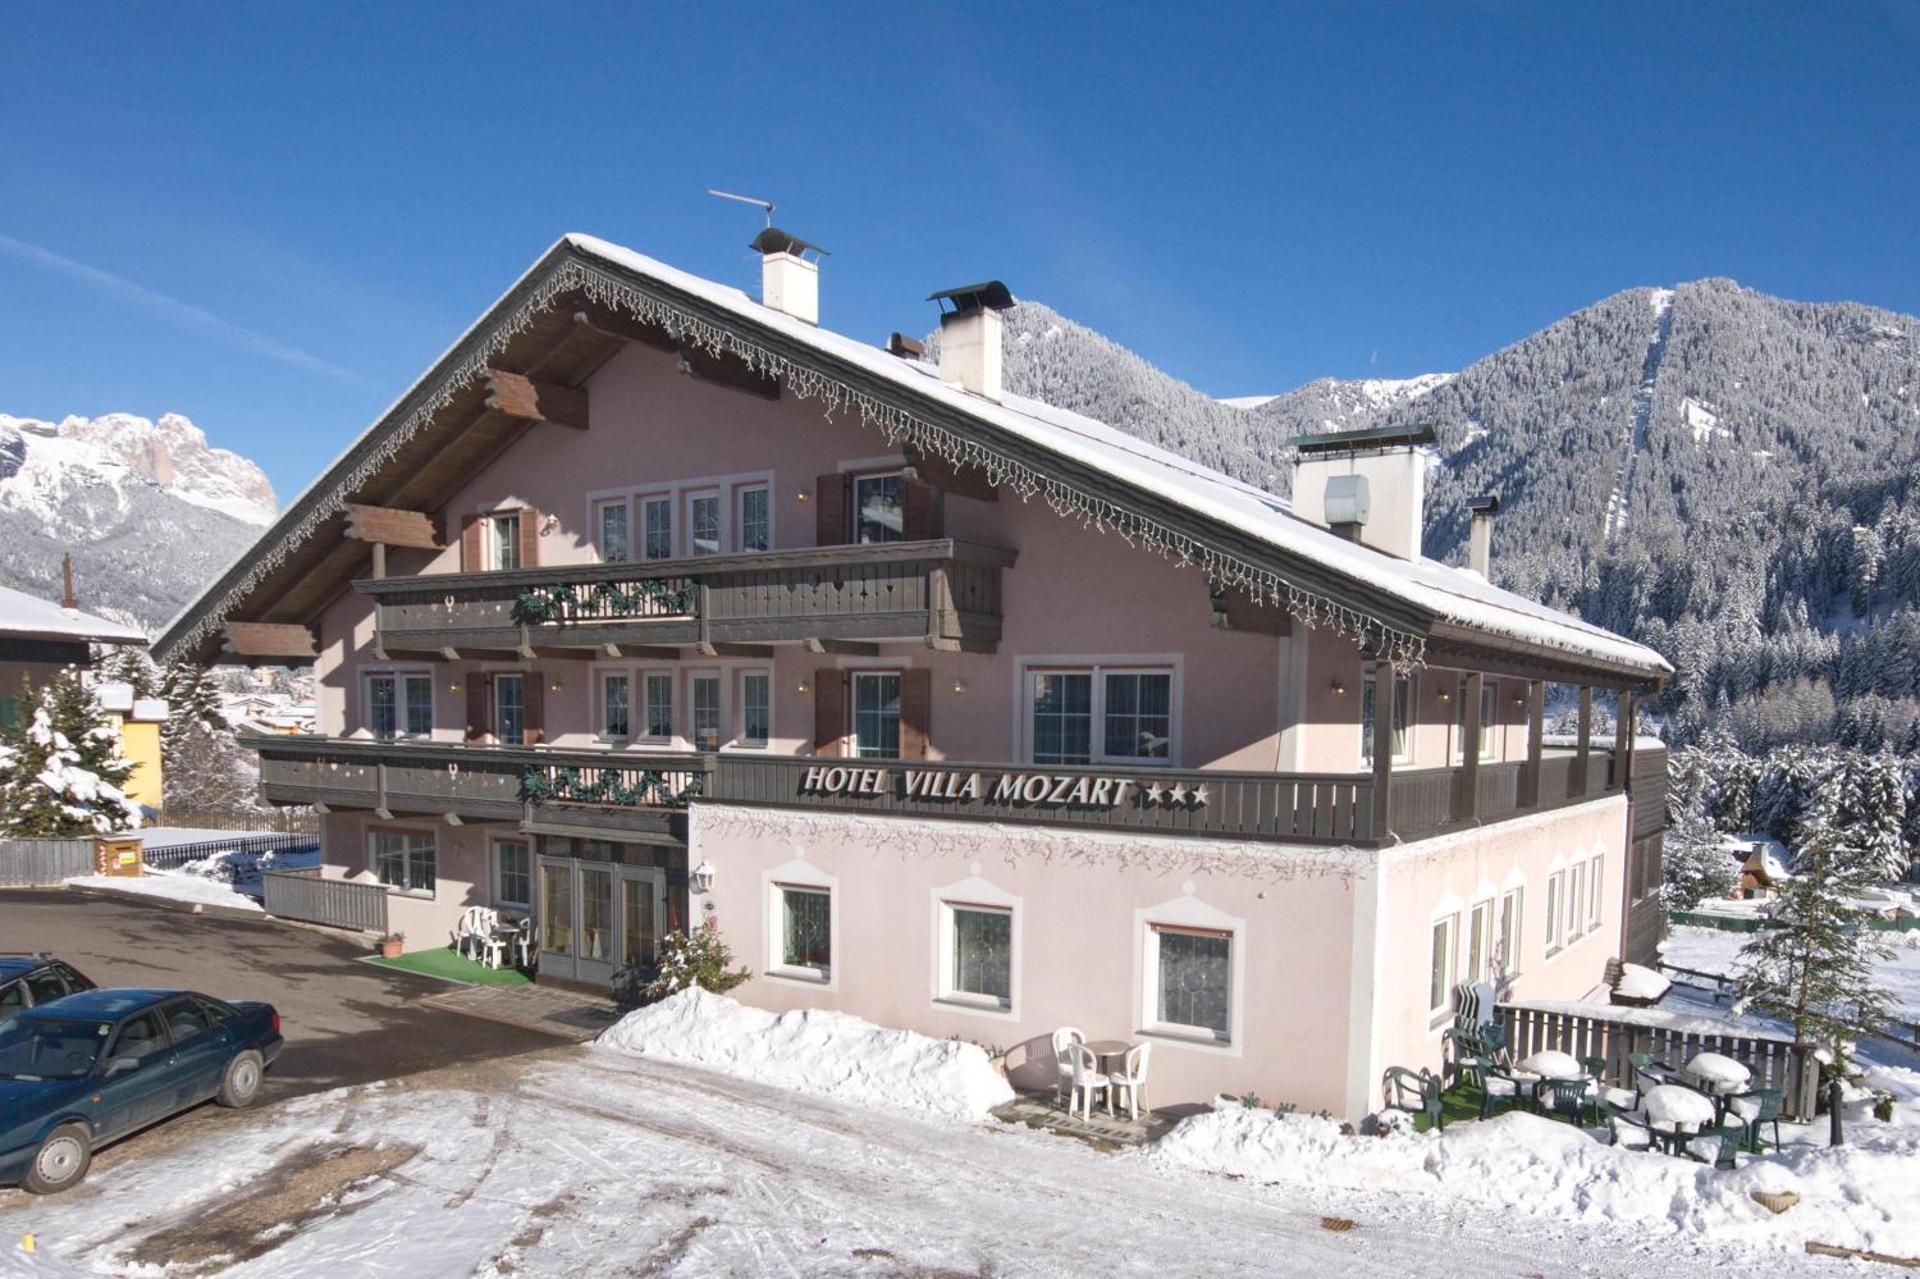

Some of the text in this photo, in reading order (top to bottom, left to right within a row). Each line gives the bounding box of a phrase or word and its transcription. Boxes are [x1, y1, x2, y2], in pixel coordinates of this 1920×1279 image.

[803, 767, 1131, 806] HOTEL VILLA MOZART
